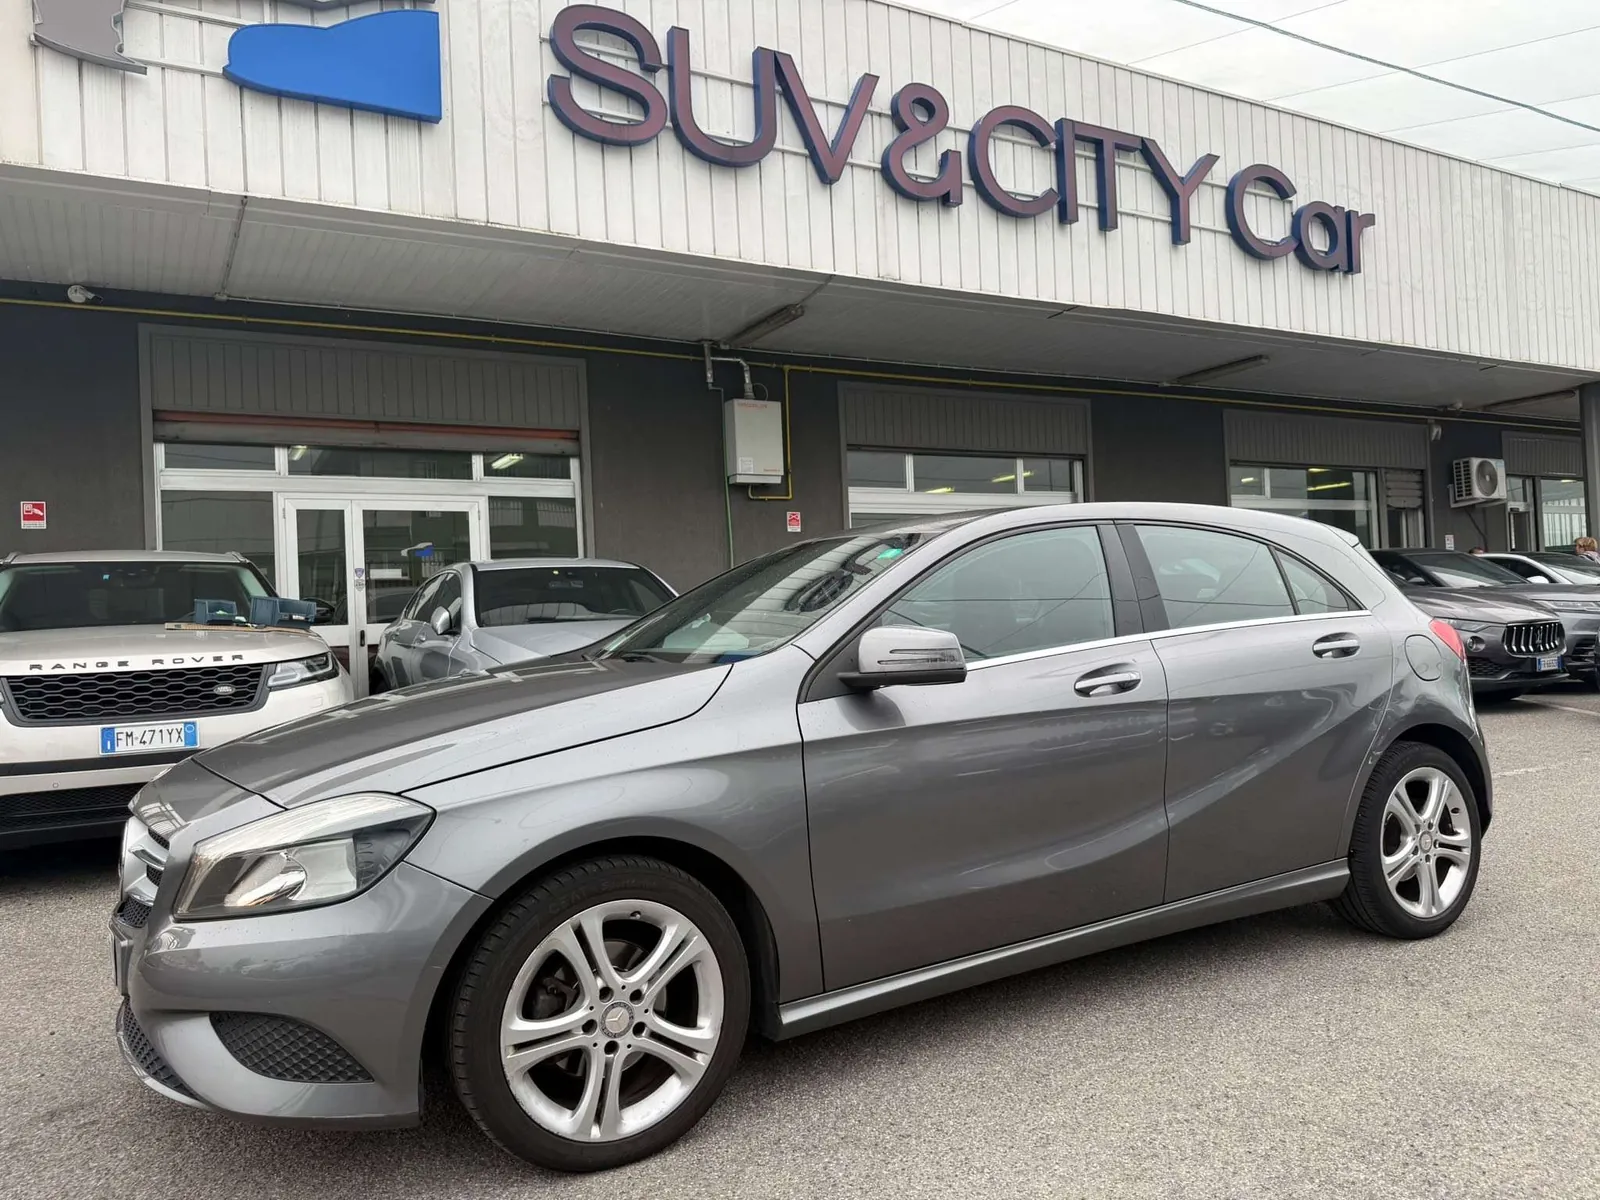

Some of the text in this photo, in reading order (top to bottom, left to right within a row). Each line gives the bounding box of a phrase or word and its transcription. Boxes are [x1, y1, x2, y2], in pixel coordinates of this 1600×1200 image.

[1226, 164, 1376, 274] Car
[29, 653, 244, 671] RANGE ROVER
